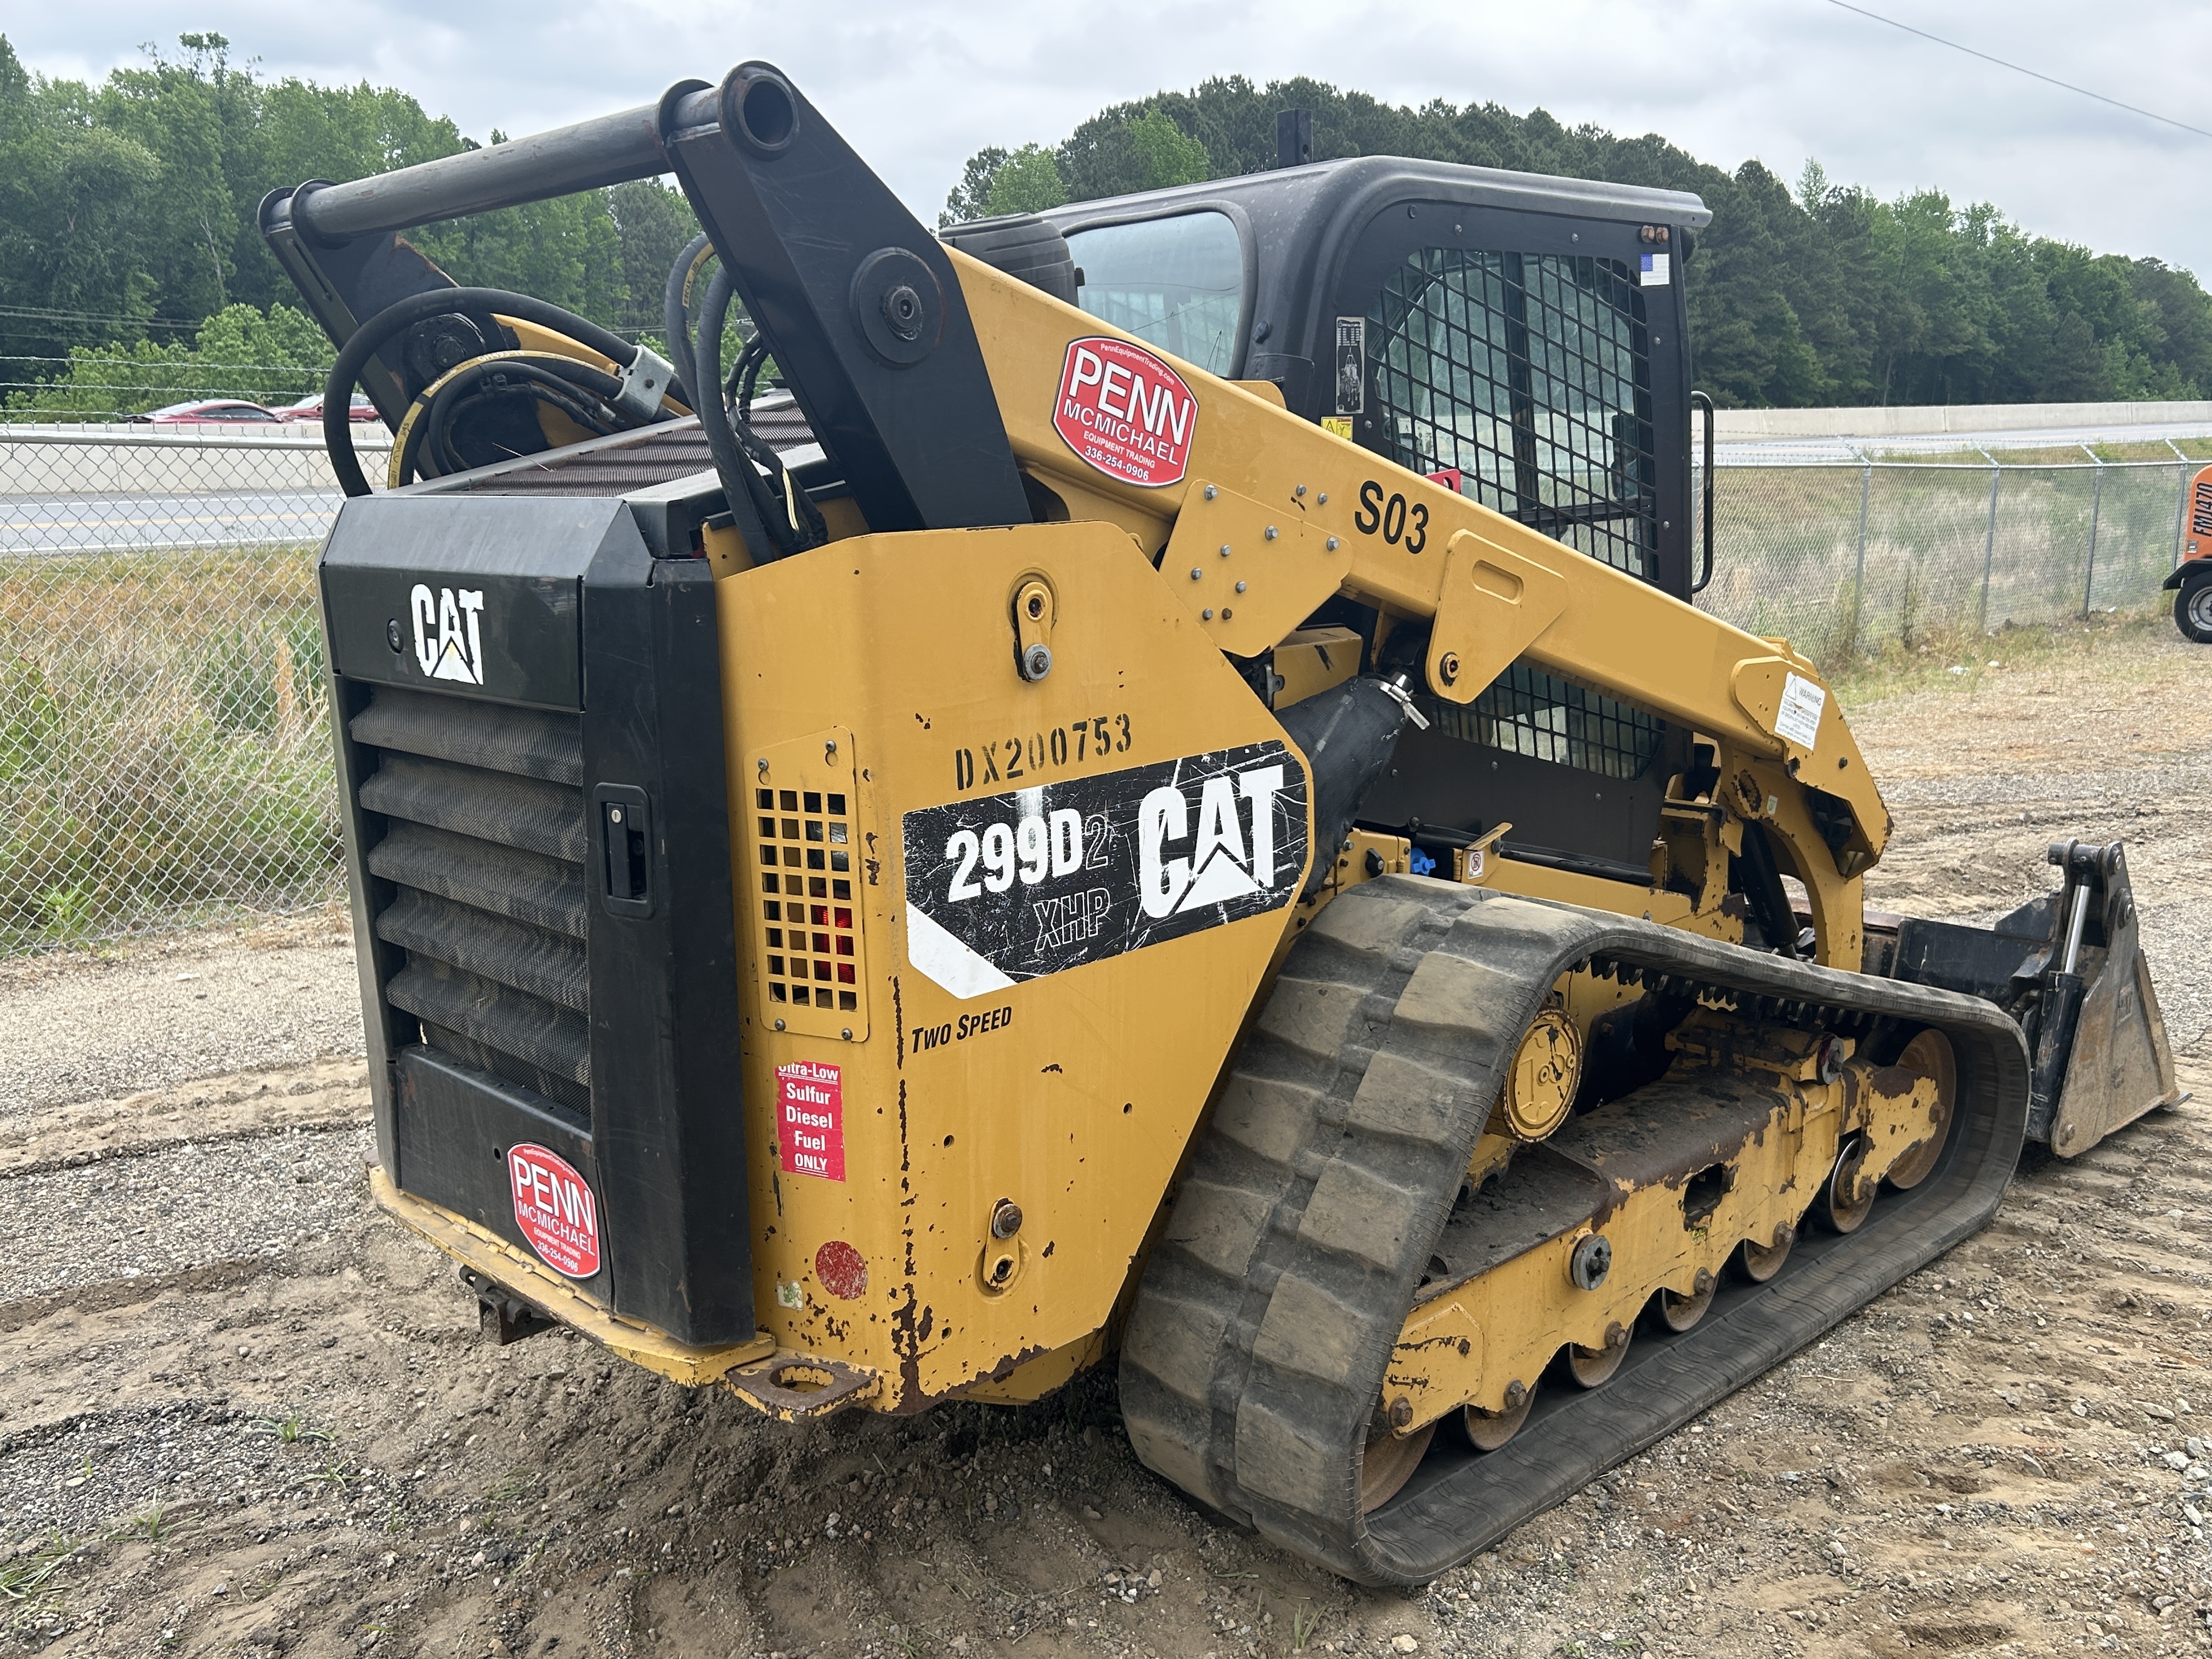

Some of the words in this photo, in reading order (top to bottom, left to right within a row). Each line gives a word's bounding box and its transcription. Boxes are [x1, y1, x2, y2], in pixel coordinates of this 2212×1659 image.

[1101, 343, 1175, 385] PennEquipmentTrading.com
[1069, 347, 1190, 446] PENN
[1063, 398, 1178, 465] MCMICHAEL
[1083, 430, 1125, 455] EQUIPMENT
[1125, 448, 1155, 469] TRADING
[1085, 445, 1149, 481] 336-254-0906
[1355, 480, 1429, 555] S03
[410, 583, 484, 685] CAT
[955, 713, 1132, 790] DX200753
[945, 808, 1109, 904] 299D2
[1138, 764, 1284, 918] CAT
[1033, 887, 1111, 952] XHP
[786, 1082, 831, 1105] Sulfur
[786, 1105, 833, 1129] Diesel
[794, 1130, 826, 1151] Fuel
[795, 1153, 827, 1171] ONLY
[512, 1154, 594, 1236] PENN
[517, 1200, 596, 1256] MCMICHAEL
[537, 1240, 579, 1272] 336-254-0906
